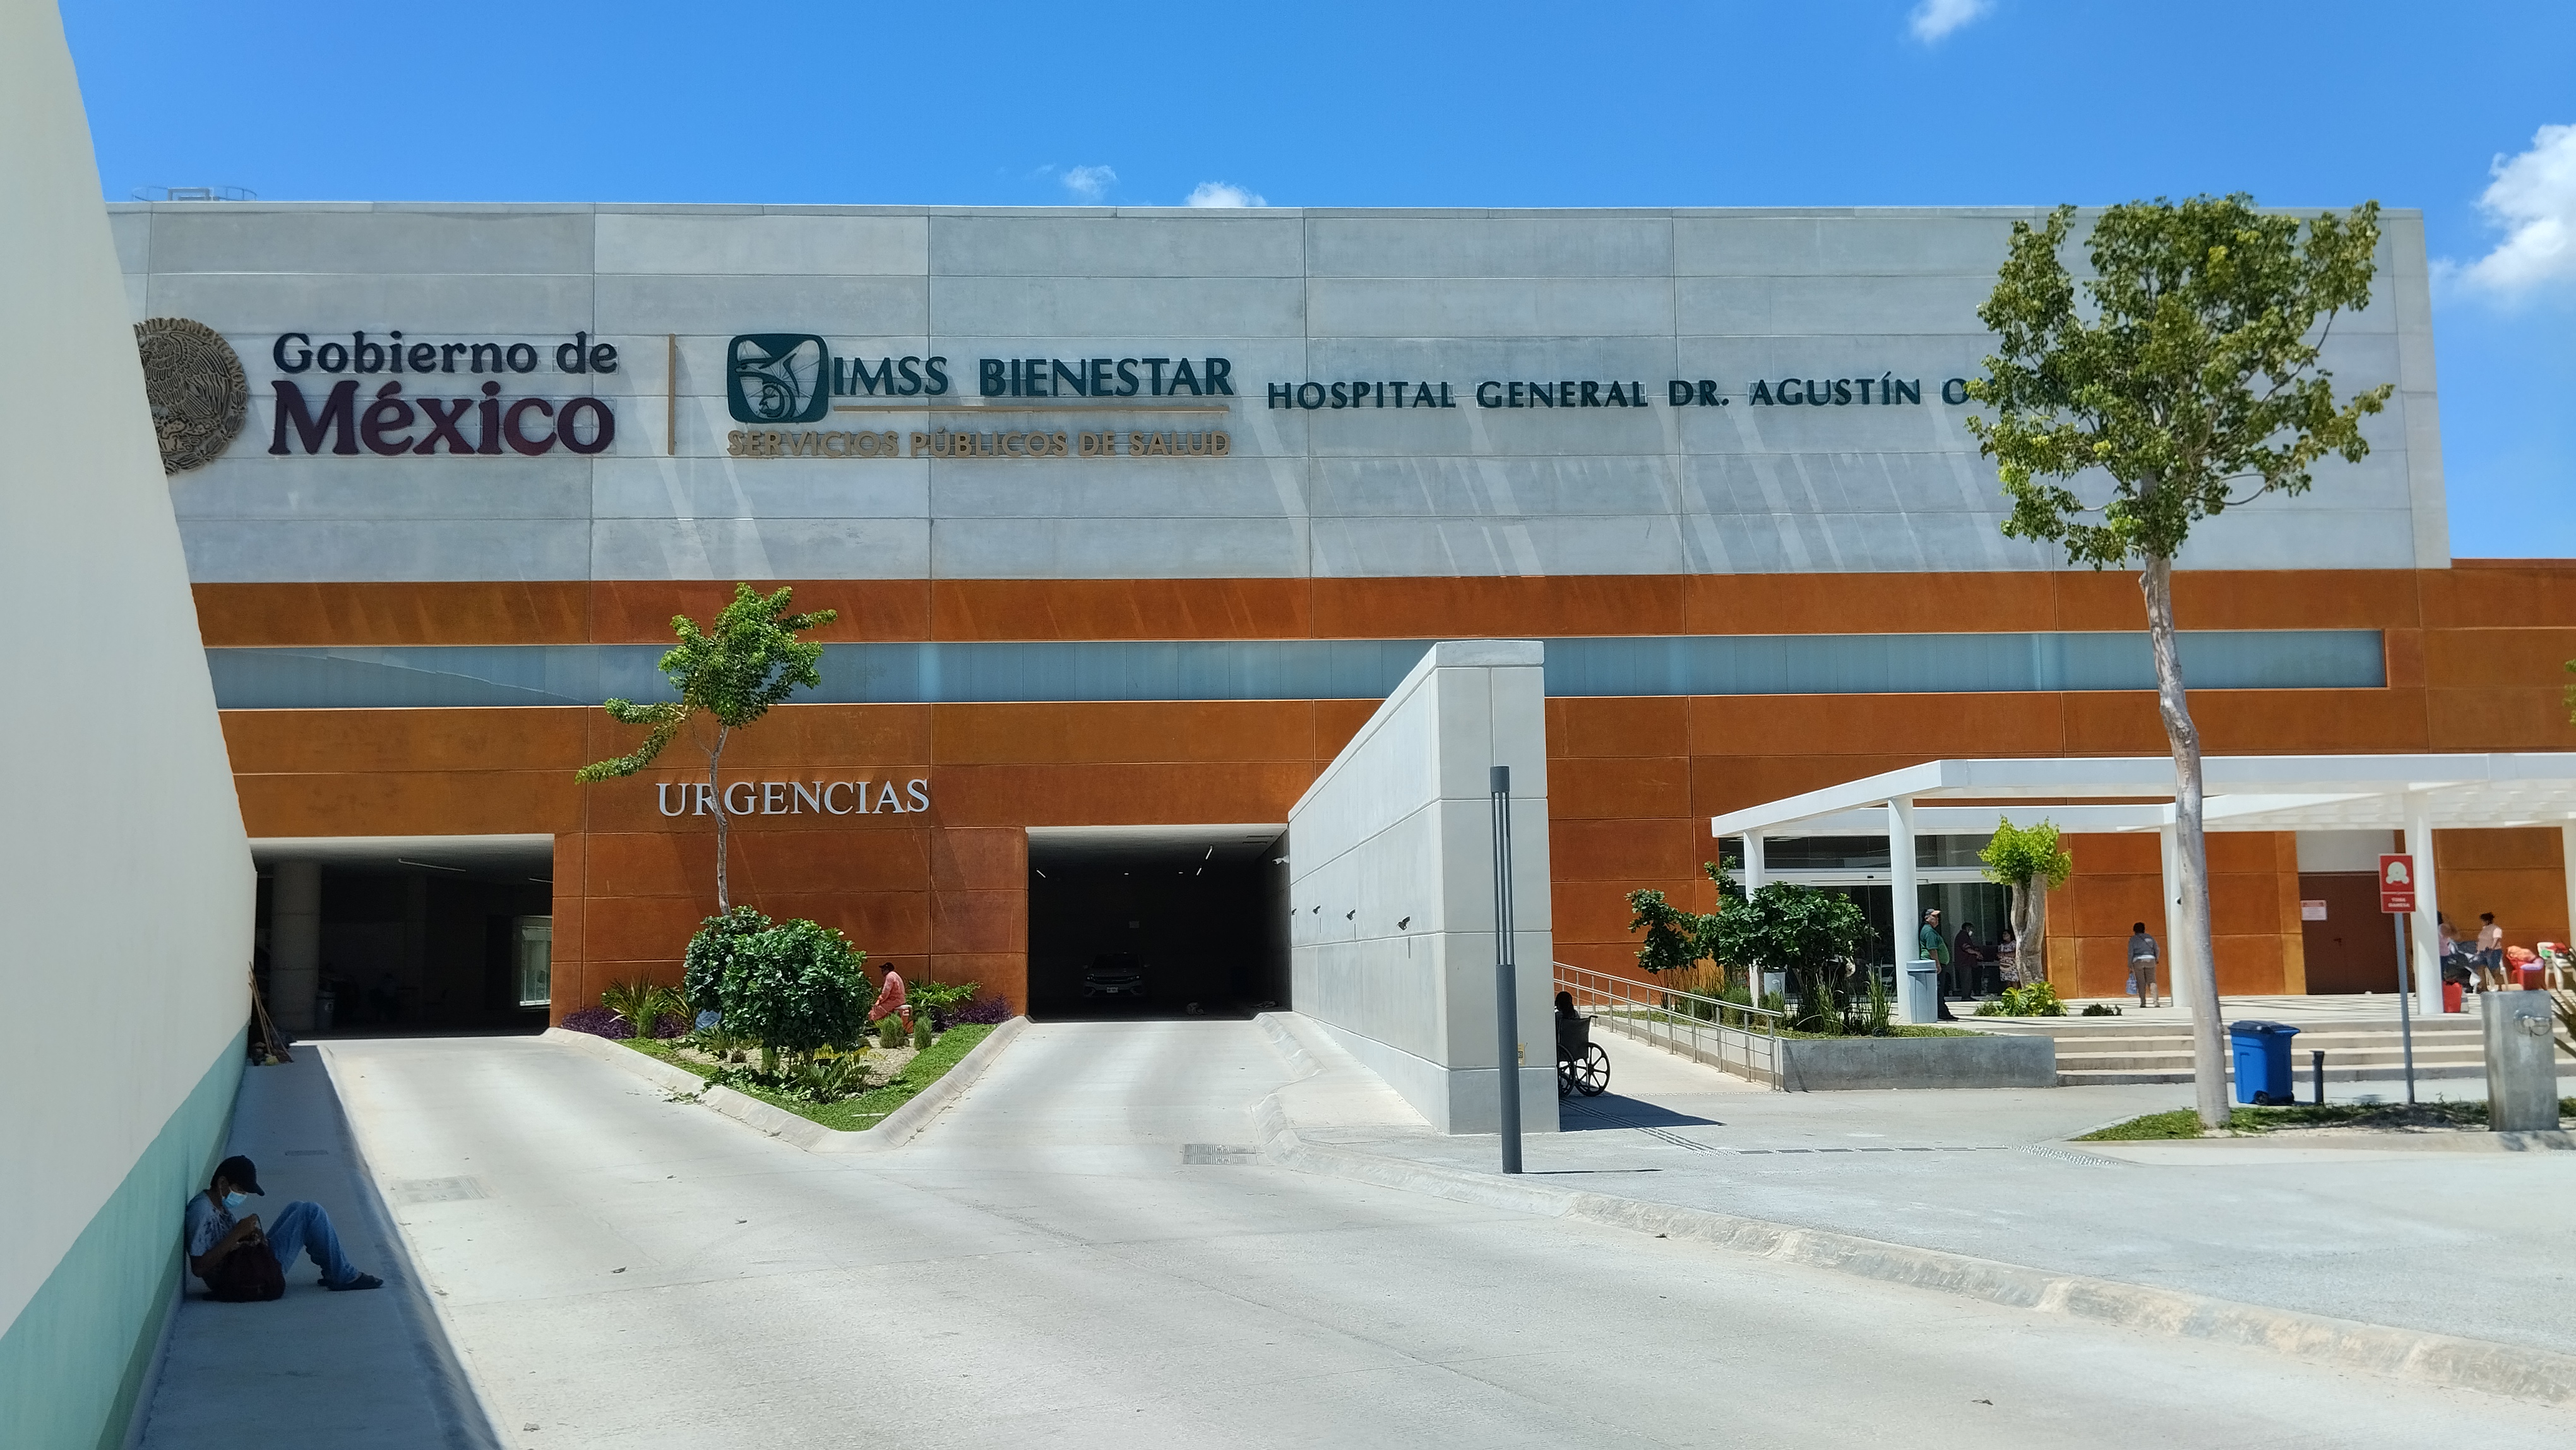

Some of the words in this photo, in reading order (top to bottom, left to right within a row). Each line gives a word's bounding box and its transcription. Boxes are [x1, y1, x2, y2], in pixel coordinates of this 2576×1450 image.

[273, 330, 538, 374] Gobierno
[556, 331, 618, 374] de
[833, 356, 948, 397] IMSS
[979, 357, 1234, 398] BIENESTAR
[1268, 381, 1457, 410] HOSPITAL
[1476, 381, 1649, 409] GENERAL
[1669, 380, 1730, 407] DR.
[1750, 371, 1921, 406] AGUSTÍN
[268, 380, 616, 457] México
[727, 429, 899, 457] SERVICIOS
[910, 426, 1069, 457] PÚBLICOS
[1079, 431, 1116, 457] DE
[1128, 430, 1231, 457] SALUD
[655, 779, 931, 817] URGENCIAS
